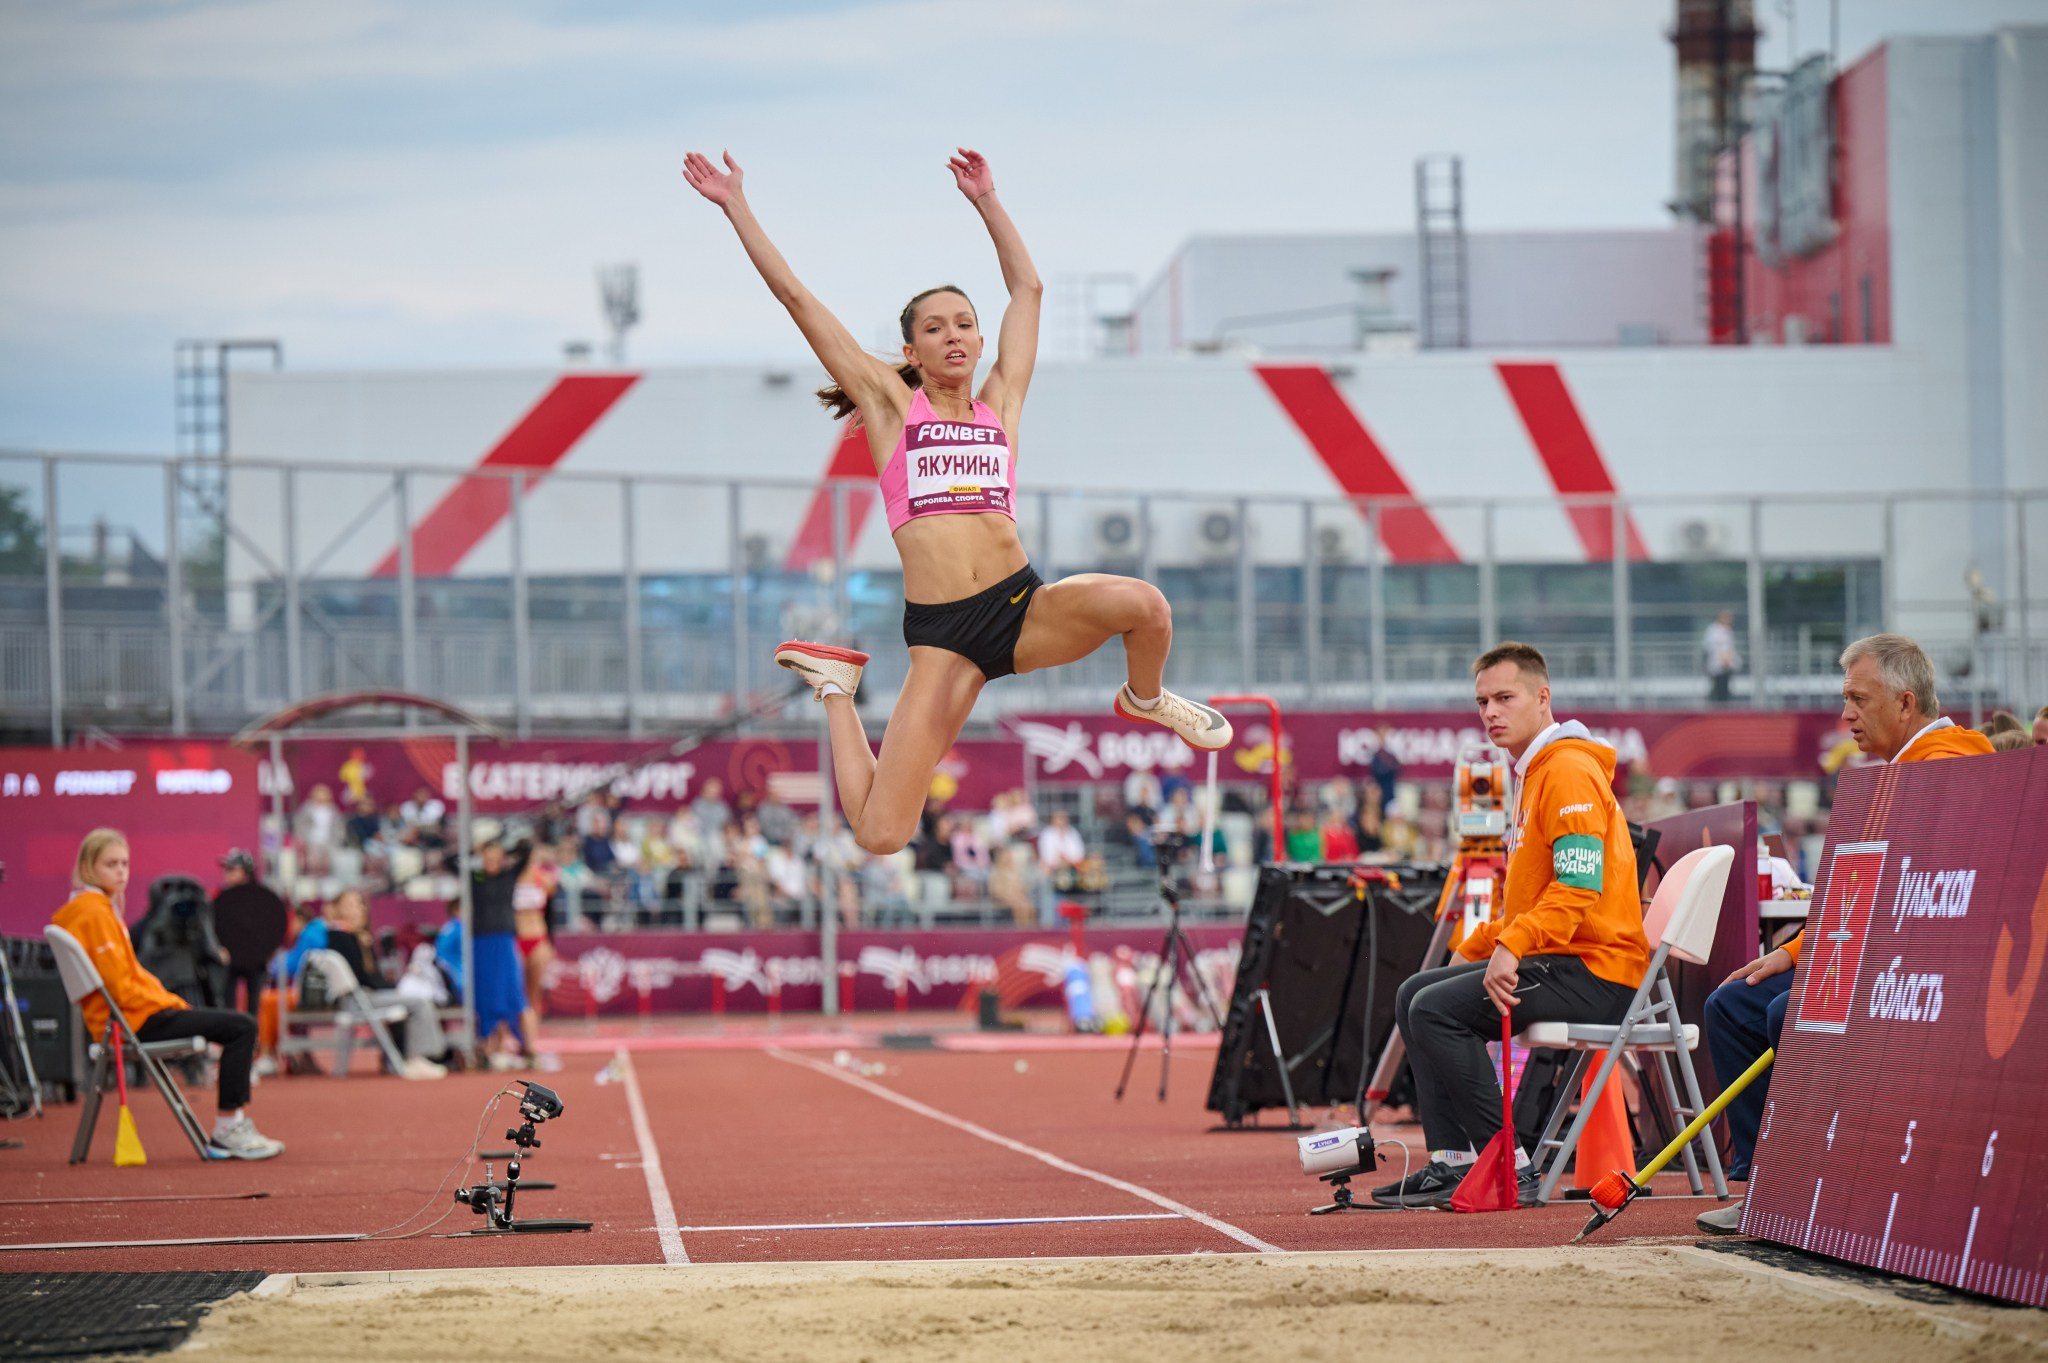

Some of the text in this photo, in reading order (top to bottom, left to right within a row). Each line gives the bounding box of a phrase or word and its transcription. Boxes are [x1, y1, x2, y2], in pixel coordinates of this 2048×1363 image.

[917, 424, 998, 442] FONBET
[917, 455, 1000, 477] ЯКУНИНА
[914, 497, 953, 507] КОРОЛЕВА
[1560, 803, 1594, 817] FONBET
[1892, 857, 1977, 932] Тульская
[1869, 955, 1944, 1022] область
[1317, 1139, 1333, 1148] LYNX
[1762, 1101, 1998, 1177] 3 4 5 6
